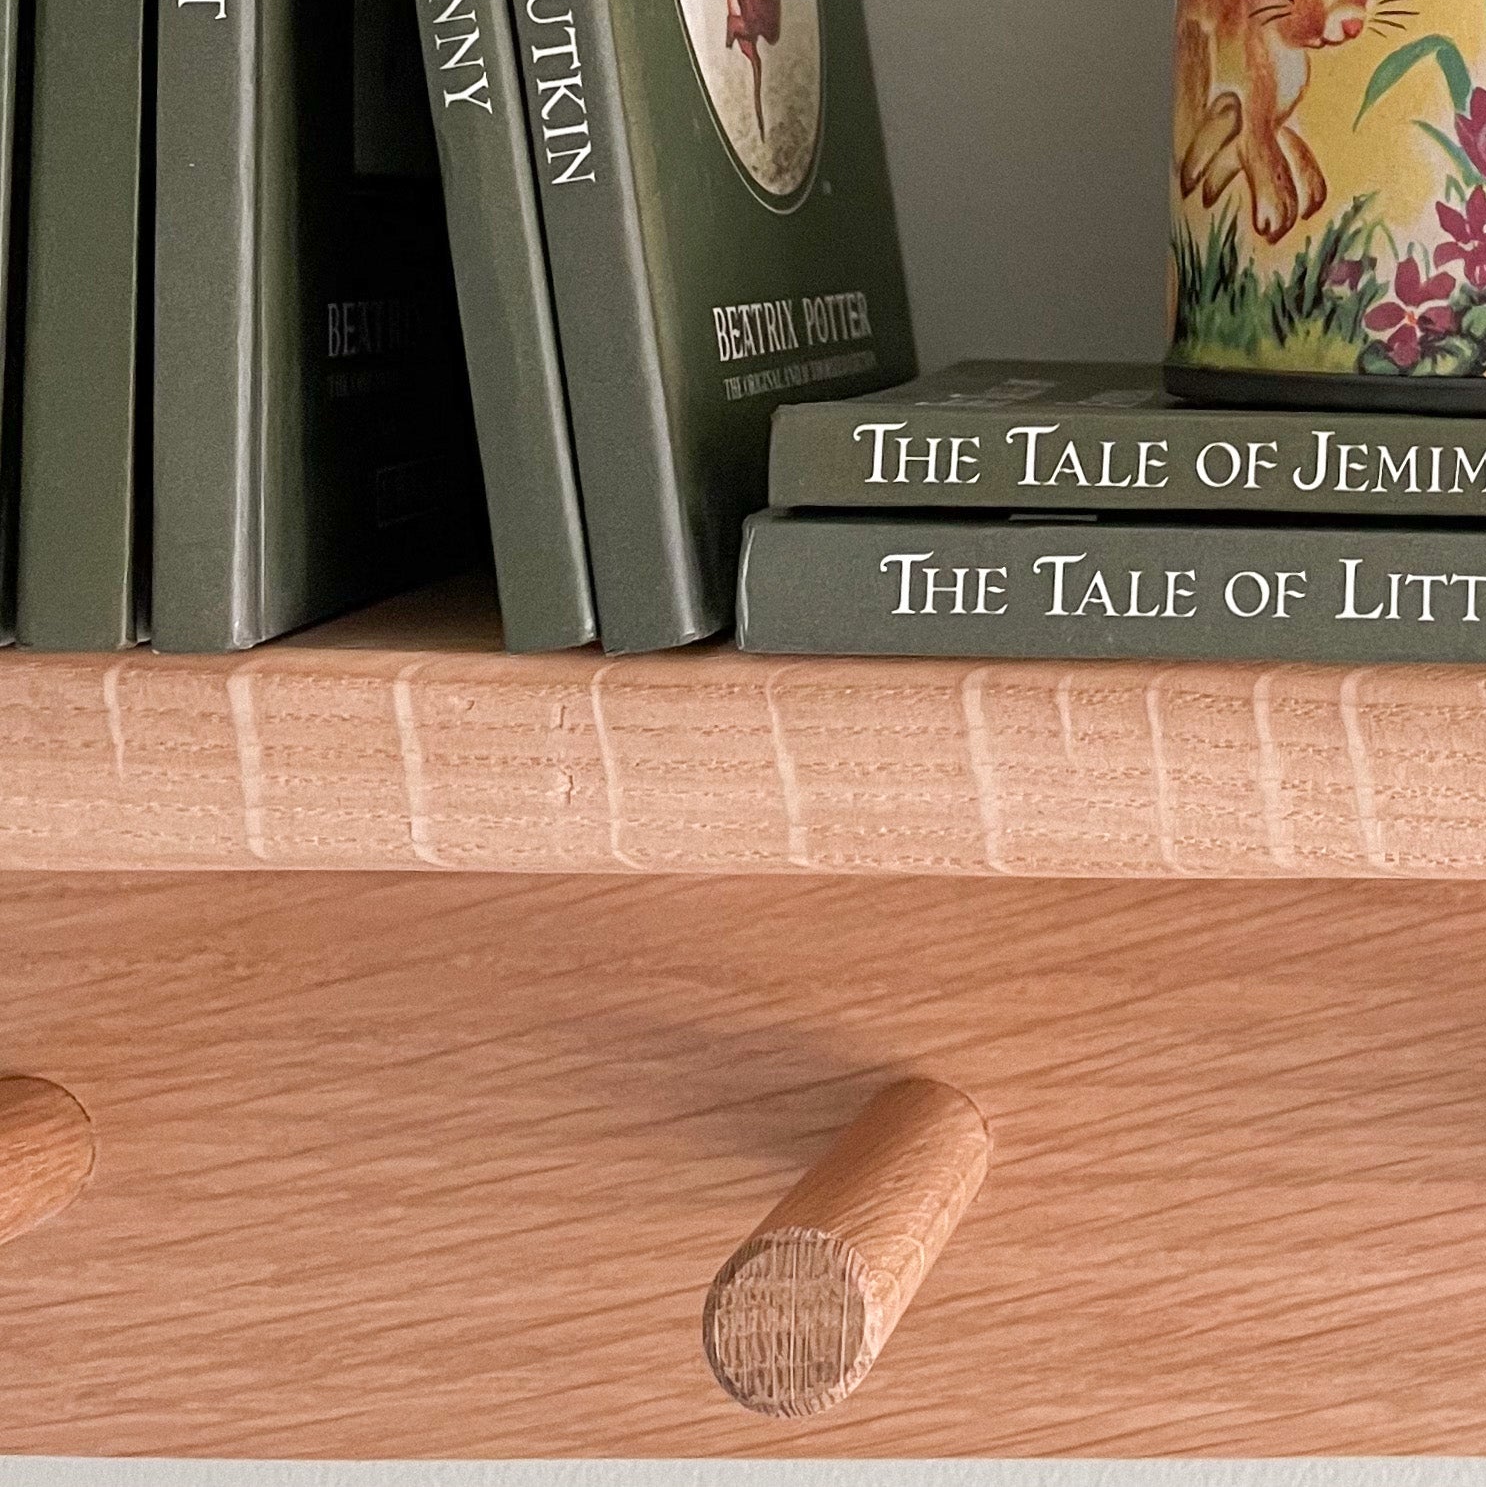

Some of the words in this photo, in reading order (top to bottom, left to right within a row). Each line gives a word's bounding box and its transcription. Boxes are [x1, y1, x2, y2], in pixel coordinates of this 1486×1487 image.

[712, 299, 799, 362] BEATRIX
[801, 291, 872, 346] POTTER
[852, 420, 981, 484] THE
[1005, 422, 1169, 488] TALE
[1195, 440, 1278, 489] OF
[879, 550, 1009, 615] THE
[1032, 552, 1198, 618] TALE
[1224, 570, 1308, 619] OF
